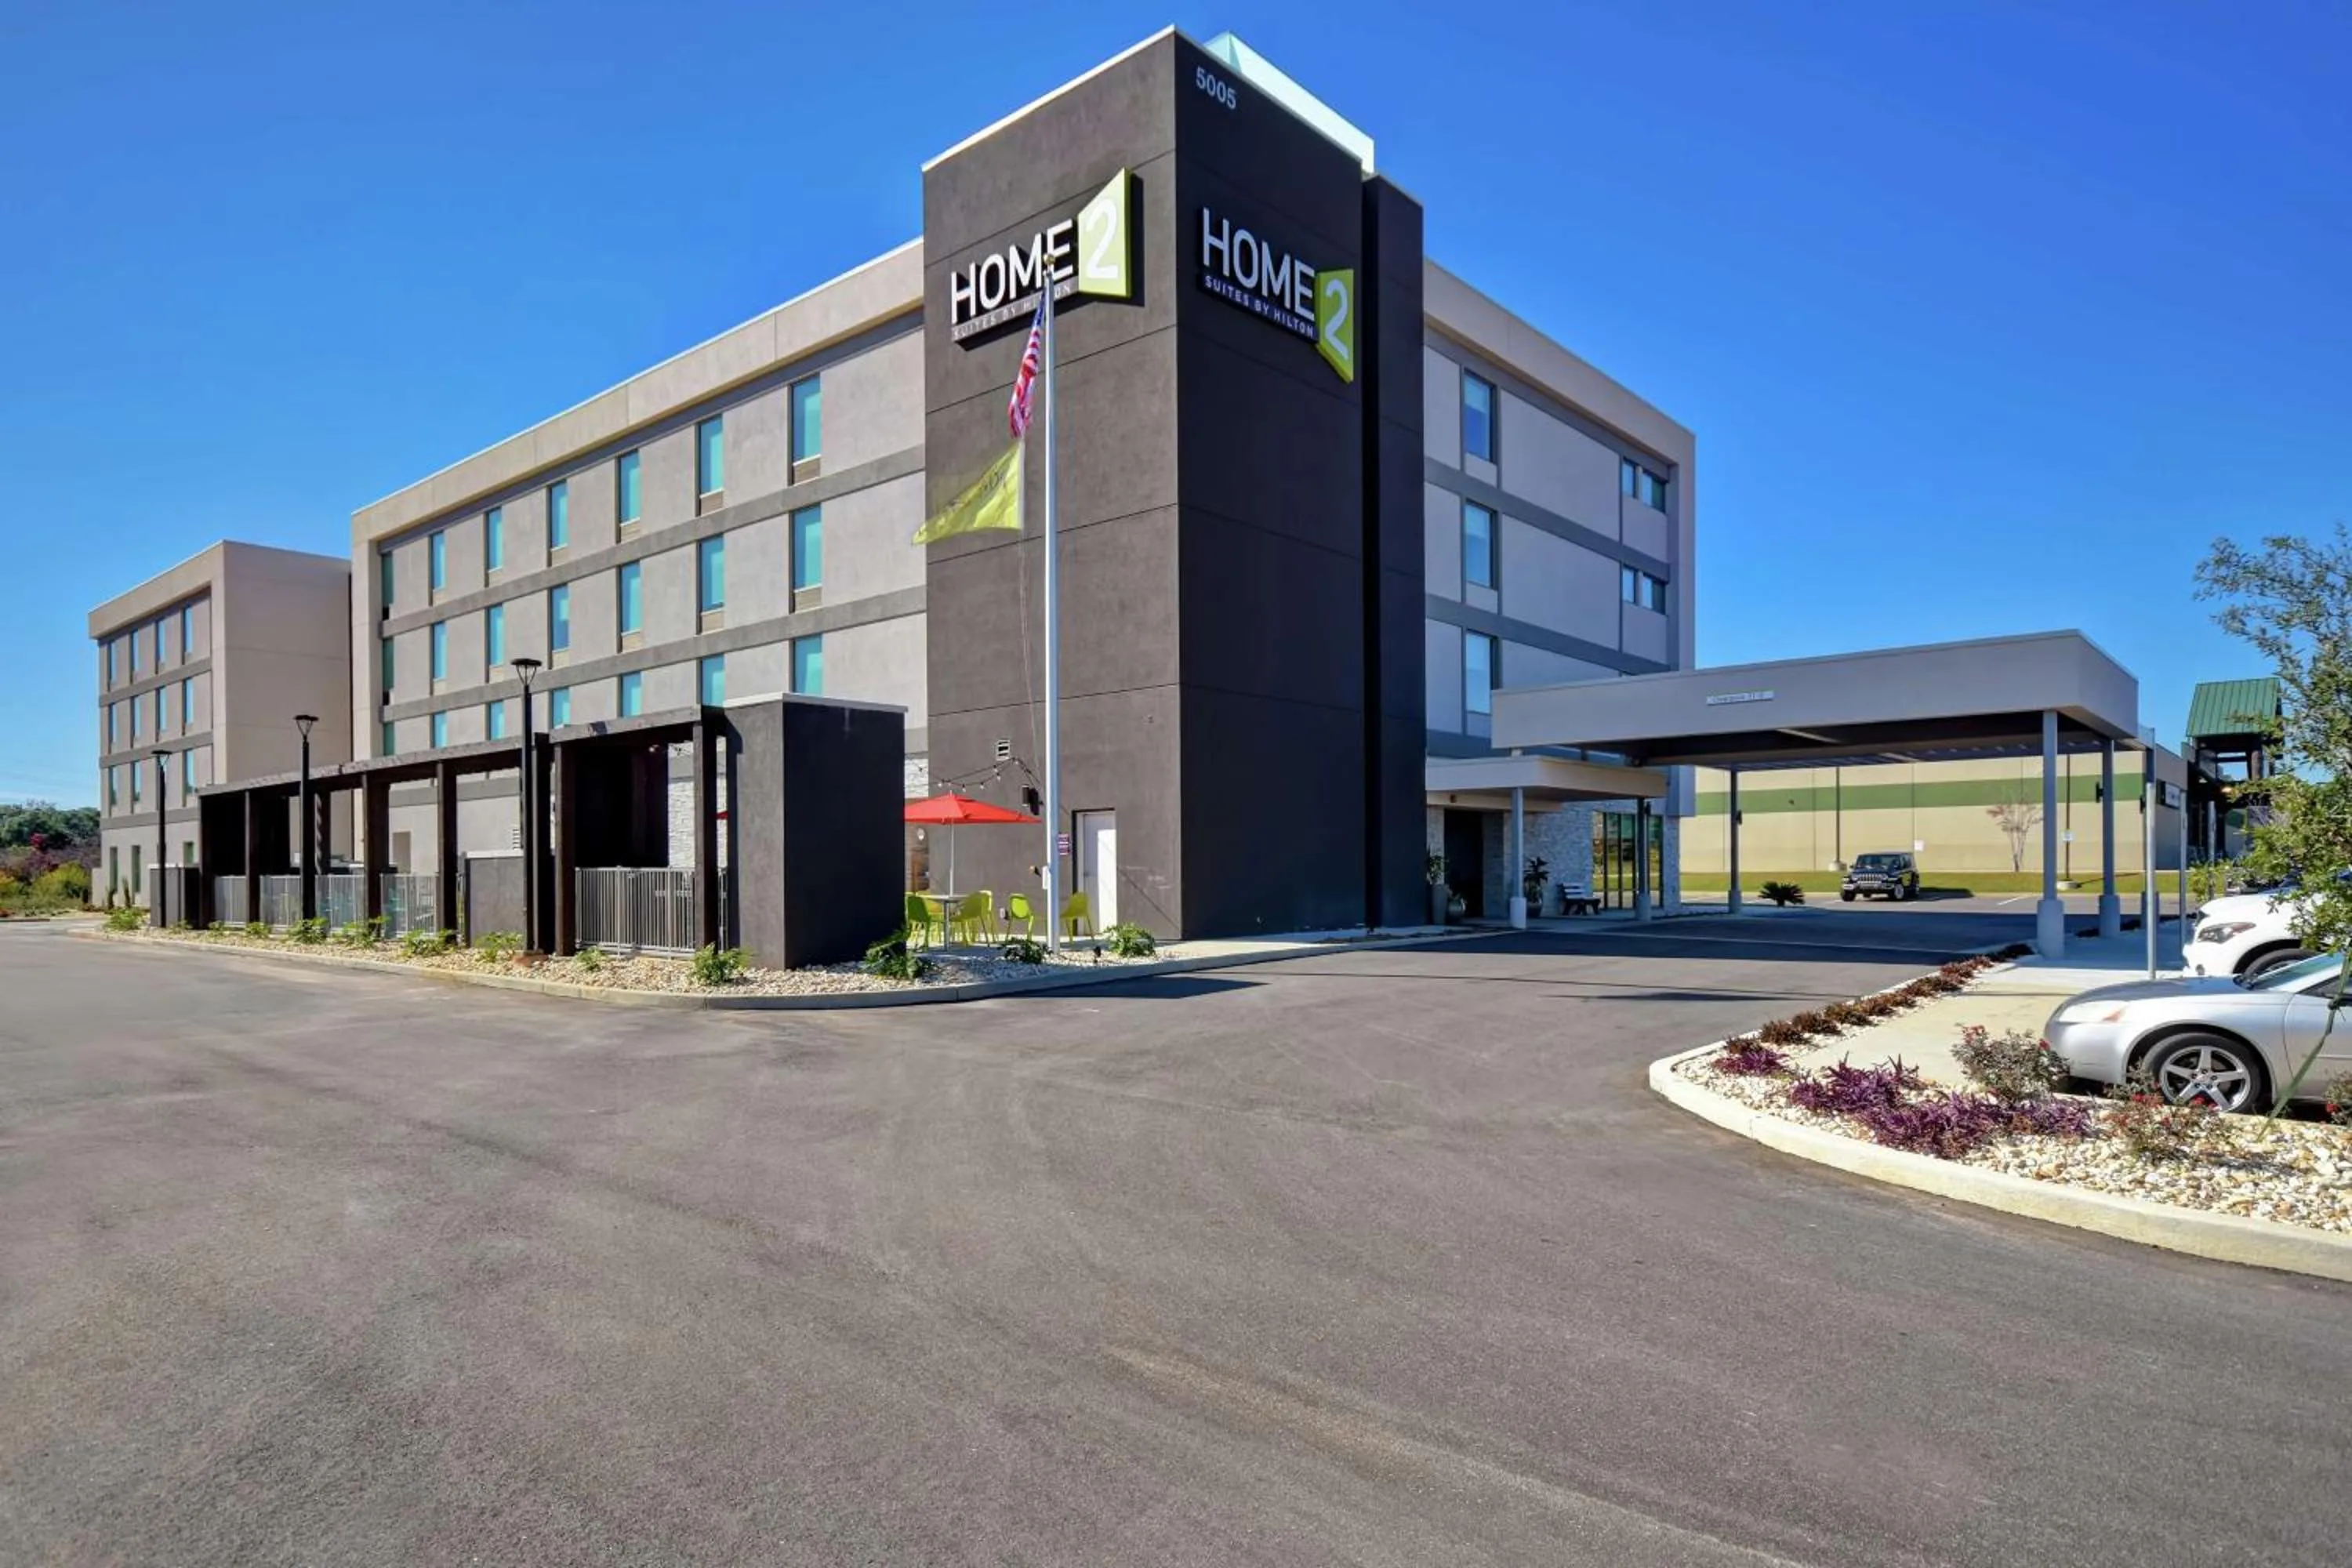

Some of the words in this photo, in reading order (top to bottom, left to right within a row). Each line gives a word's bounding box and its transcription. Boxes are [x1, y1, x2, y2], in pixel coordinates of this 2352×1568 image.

[1196, 66, 1236, 109] 5005
[951, 219, 1073, 324] HOME
[1086, 198, 1118, 279] 2
[1203, 207, 1315, 321] HOME
[1325, 278, 1348, 361] 2
[1205, 275, 1249, 307] SUITES
[1254, 299, 1269, 314] BY
[1273, 308, 1315, 340] HILTON
